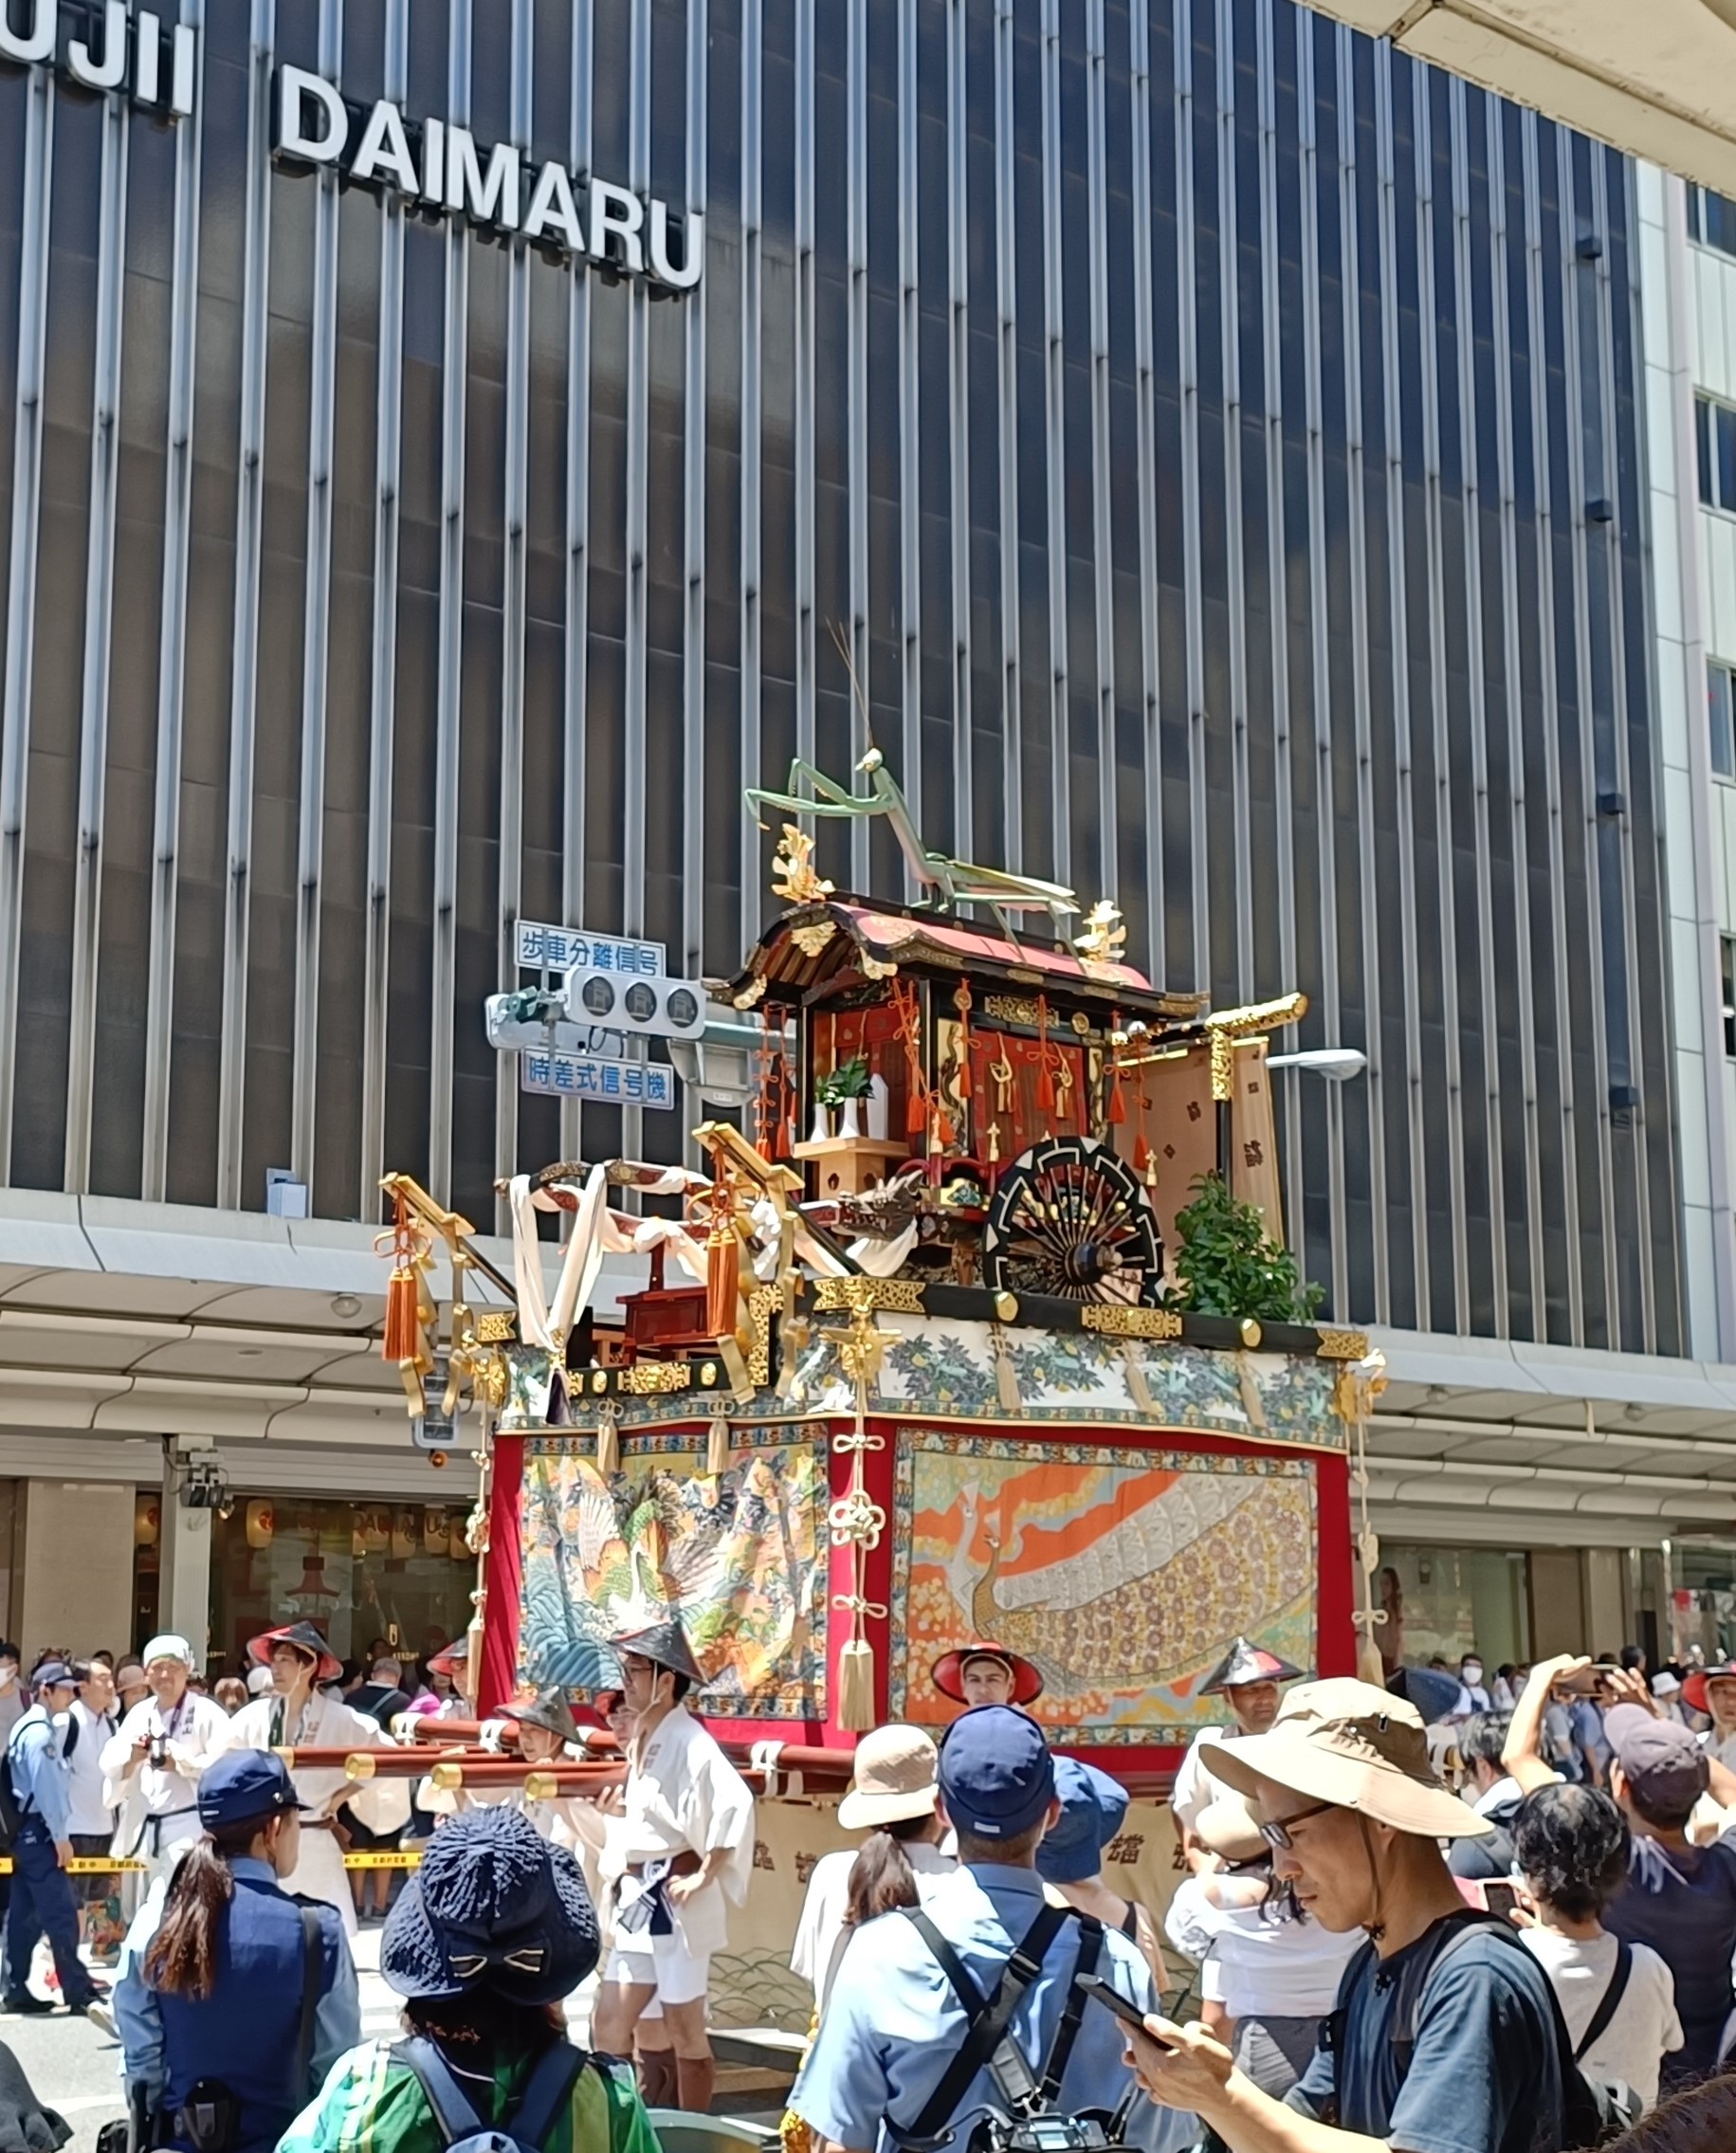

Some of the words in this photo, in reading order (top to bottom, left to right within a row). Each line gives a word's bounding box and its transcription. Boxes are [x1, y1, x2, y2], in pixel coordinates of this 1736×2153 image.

[282, 64, 704, 288] DAIMARU
[522, 931, 658, 976] 歩車分離信号
[529, 1056, 667, 1100] 時差式信号機
